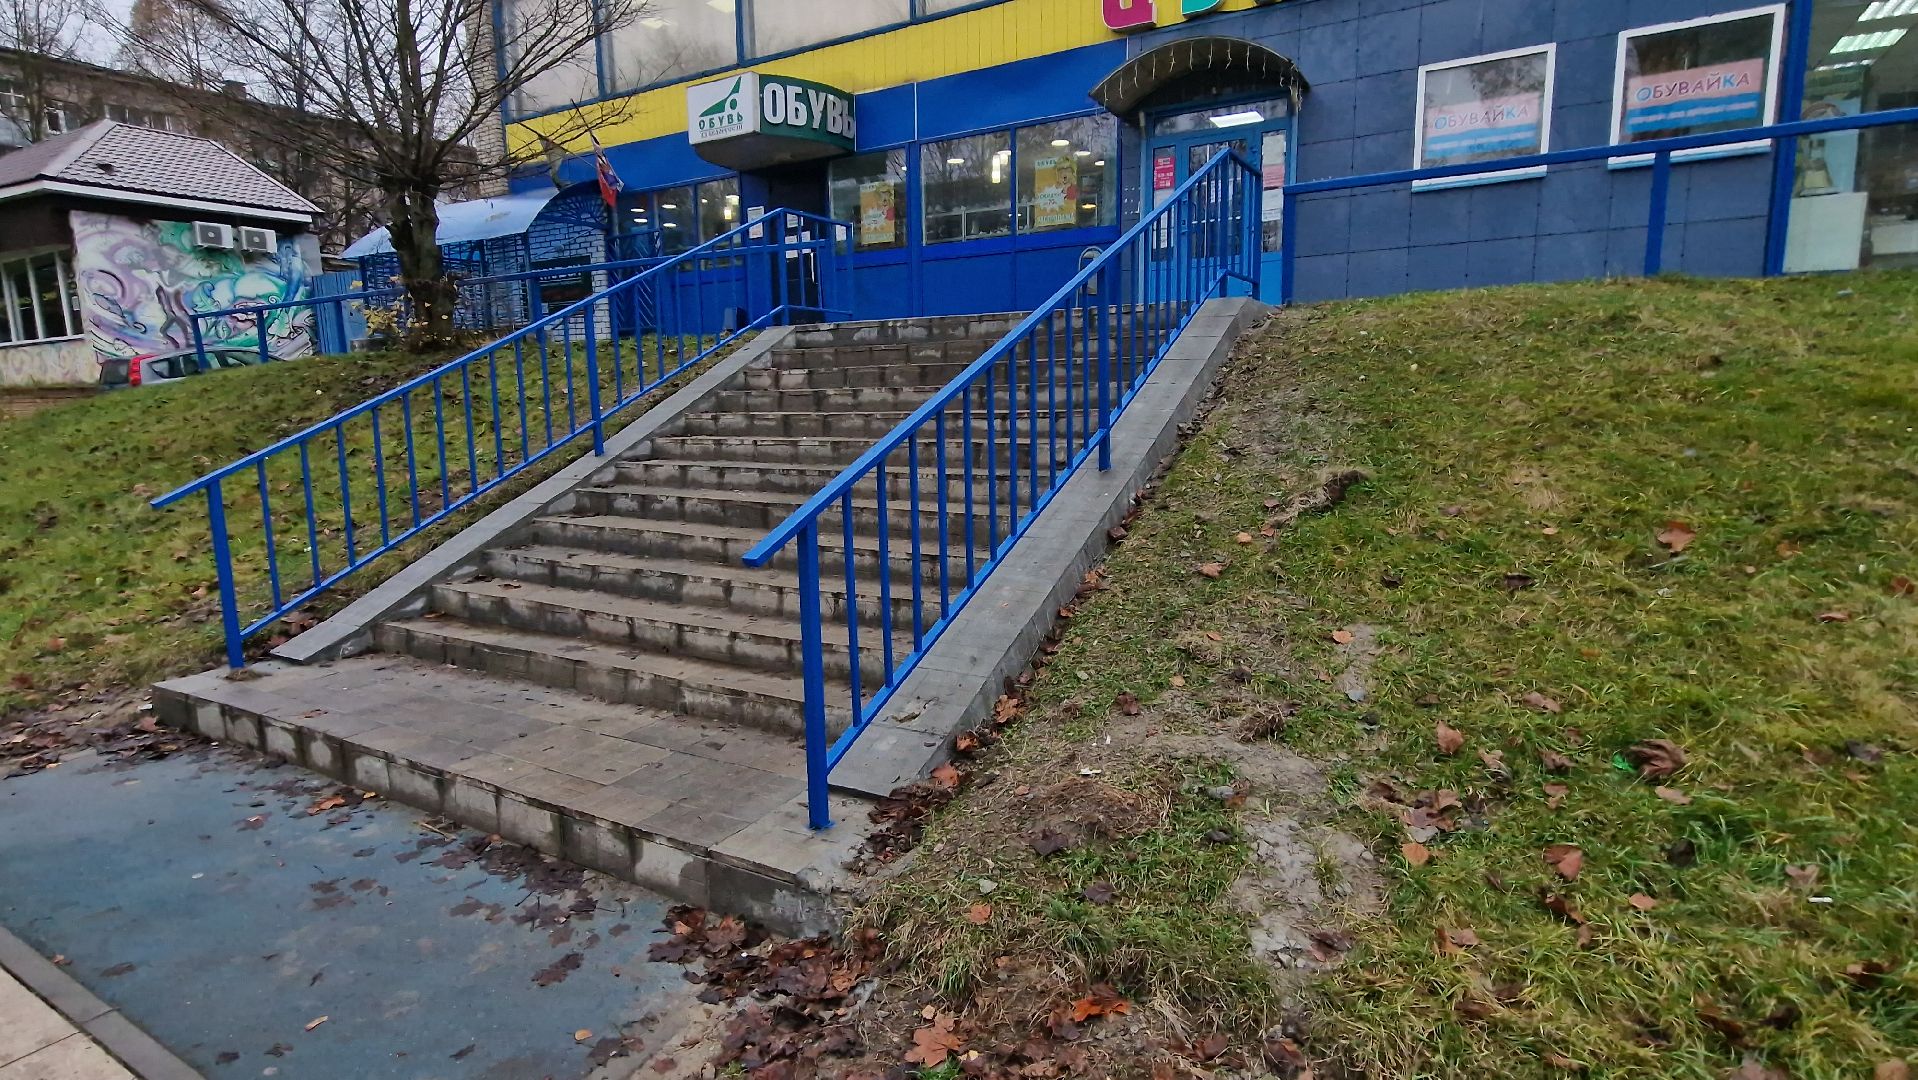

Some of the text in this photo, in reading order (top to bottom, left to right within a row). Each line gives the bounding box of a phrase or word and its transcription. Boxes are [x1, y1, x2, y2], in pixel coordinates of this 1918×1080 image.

[1636, 71, 1750, 102] ОБУВАЙКА
[699, 112, 744, 130] ОБУВЬ
[763, 82, 855, 139] ОБУВЬ
[1434, 103, 1529, 130] ОБУВАЙКА
